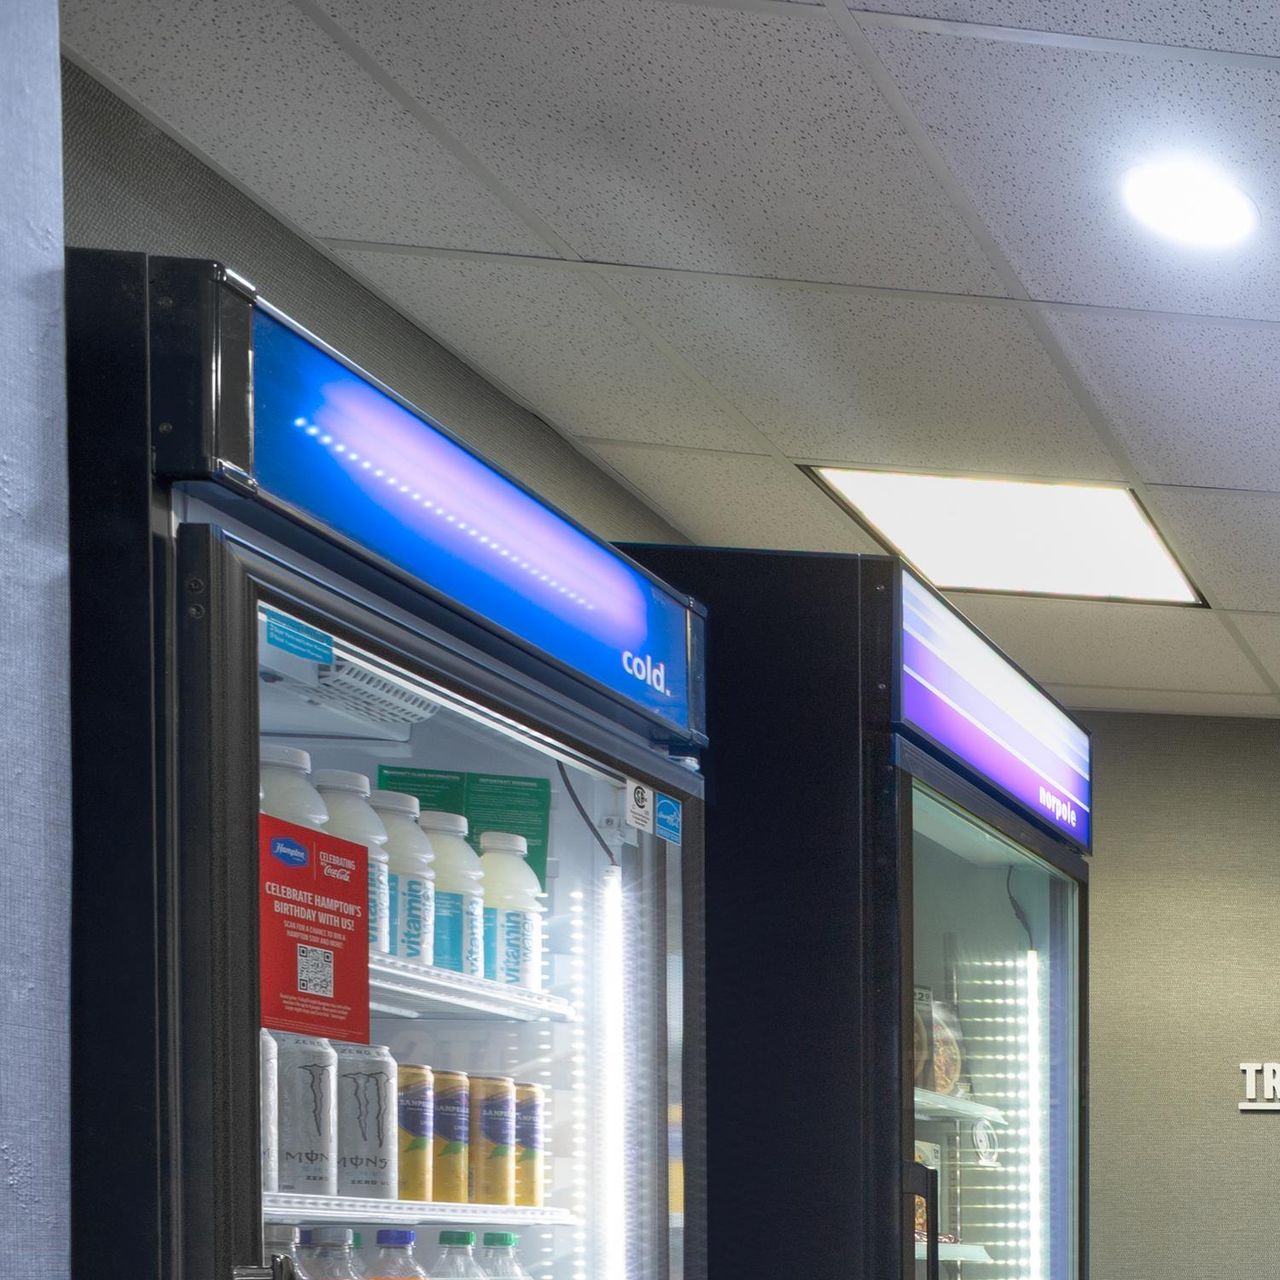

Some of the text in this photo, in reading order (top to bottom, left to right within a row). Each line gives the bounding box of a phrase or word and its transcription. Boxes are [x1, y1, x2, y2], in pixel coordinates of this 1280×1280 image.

[622, 650, 671, 697] cold.
[1039, 785, 1077, 828] norpole
[274, 841, 306, 862] Hampton
[320, 851, 356, 870] CELEBRATING
[265, 881, 314, 905] CELEBRATE
[314, 894, 362, 918] HAMPTON'S
[273, 900, 355, 931] BIRTHDAY WITH US!
[401, 880, 422, 957] vitamin
[501, 912, 520, 983] vitamin
